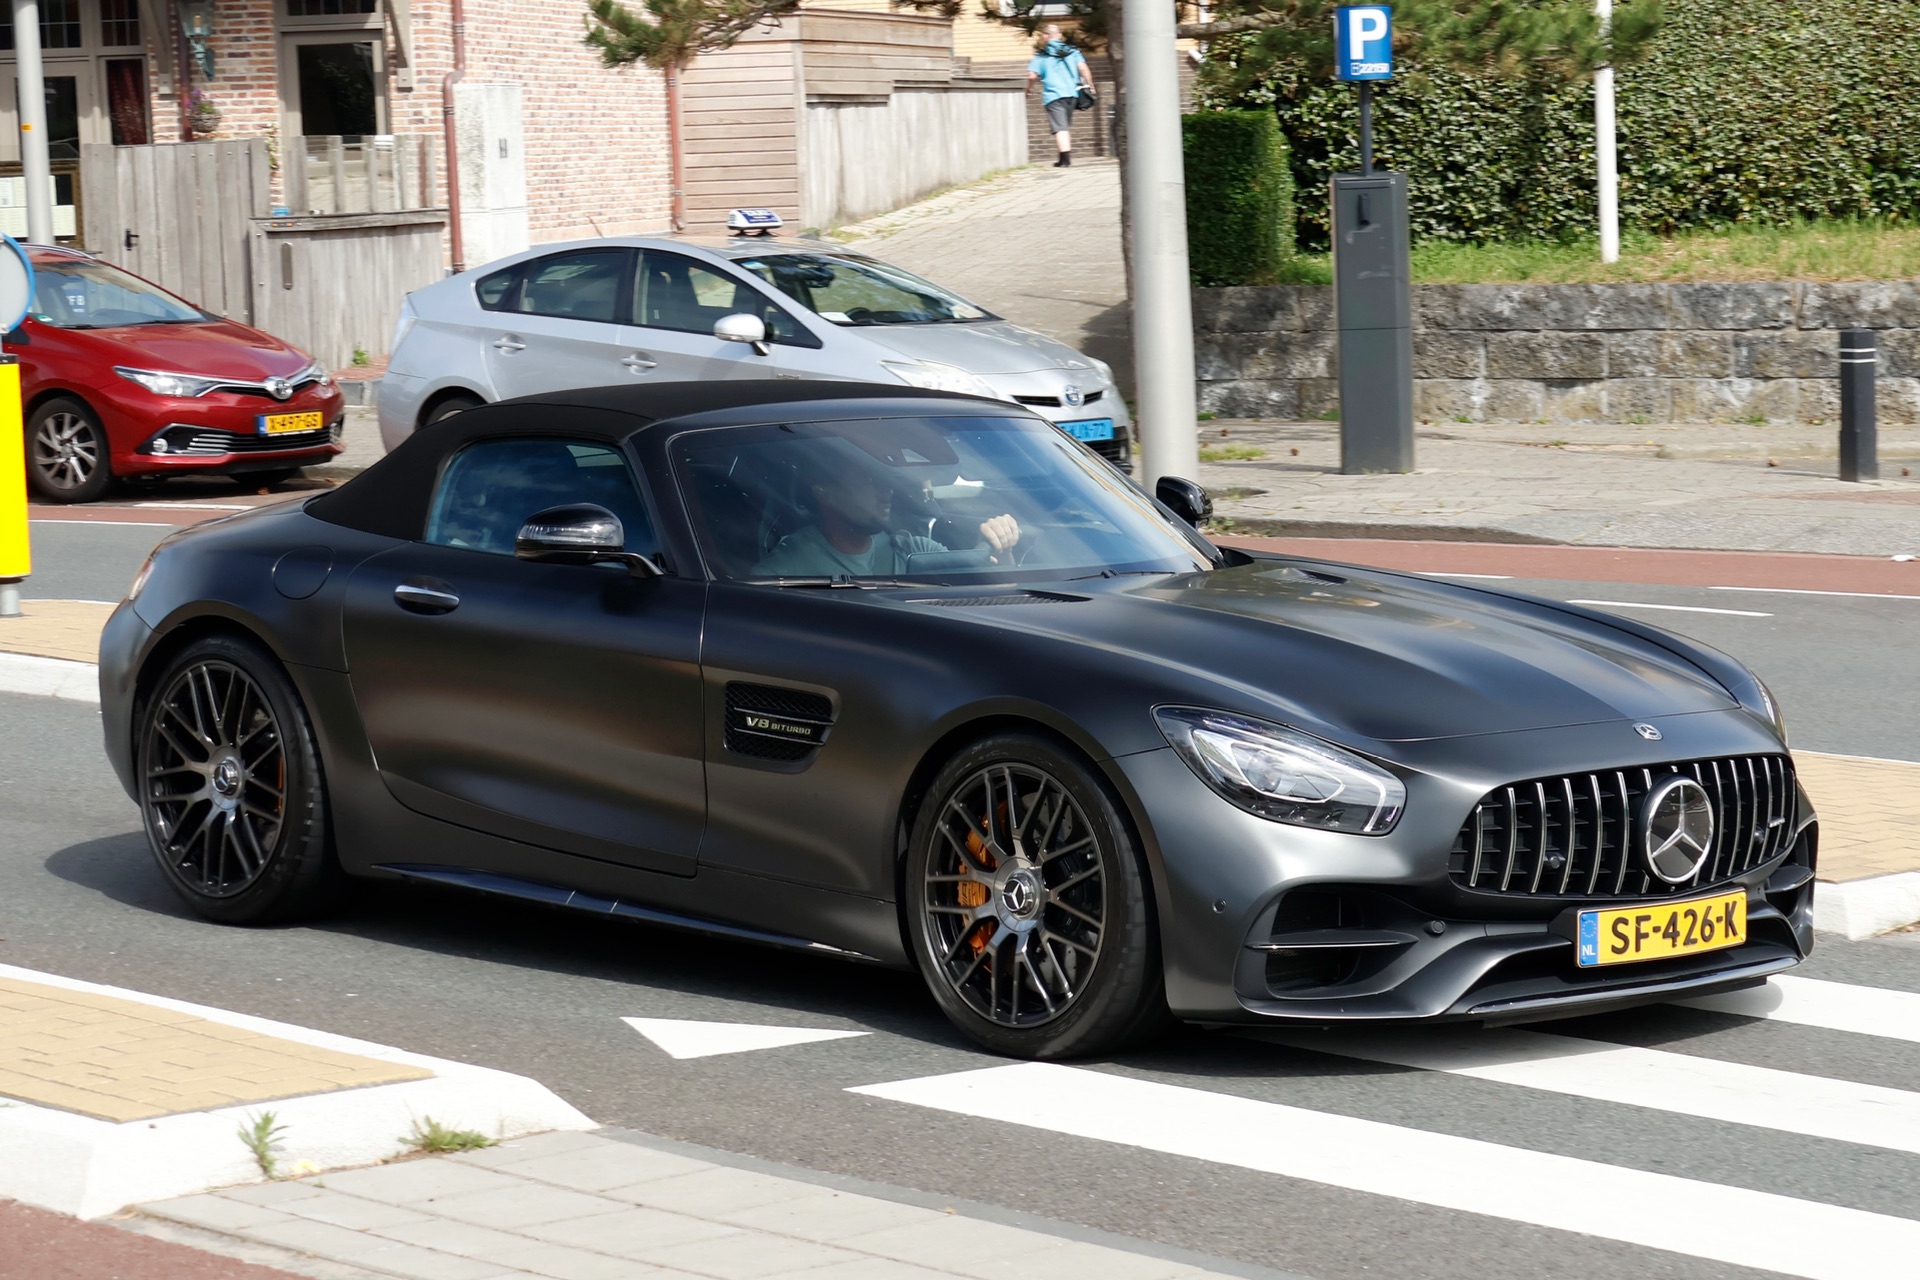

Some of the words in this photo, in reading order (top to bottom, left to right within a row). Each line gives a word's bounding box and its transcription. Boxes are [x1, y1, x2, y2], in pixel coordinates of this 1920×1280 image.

[1349, 9, 1388, 60] P
[746, 716, 770, 729] V8
[771, 722, 811, 735] BITURBO
[1611, 901, 1738, 955] SF-426-K
[1582, 944, 1596, 957] NL
